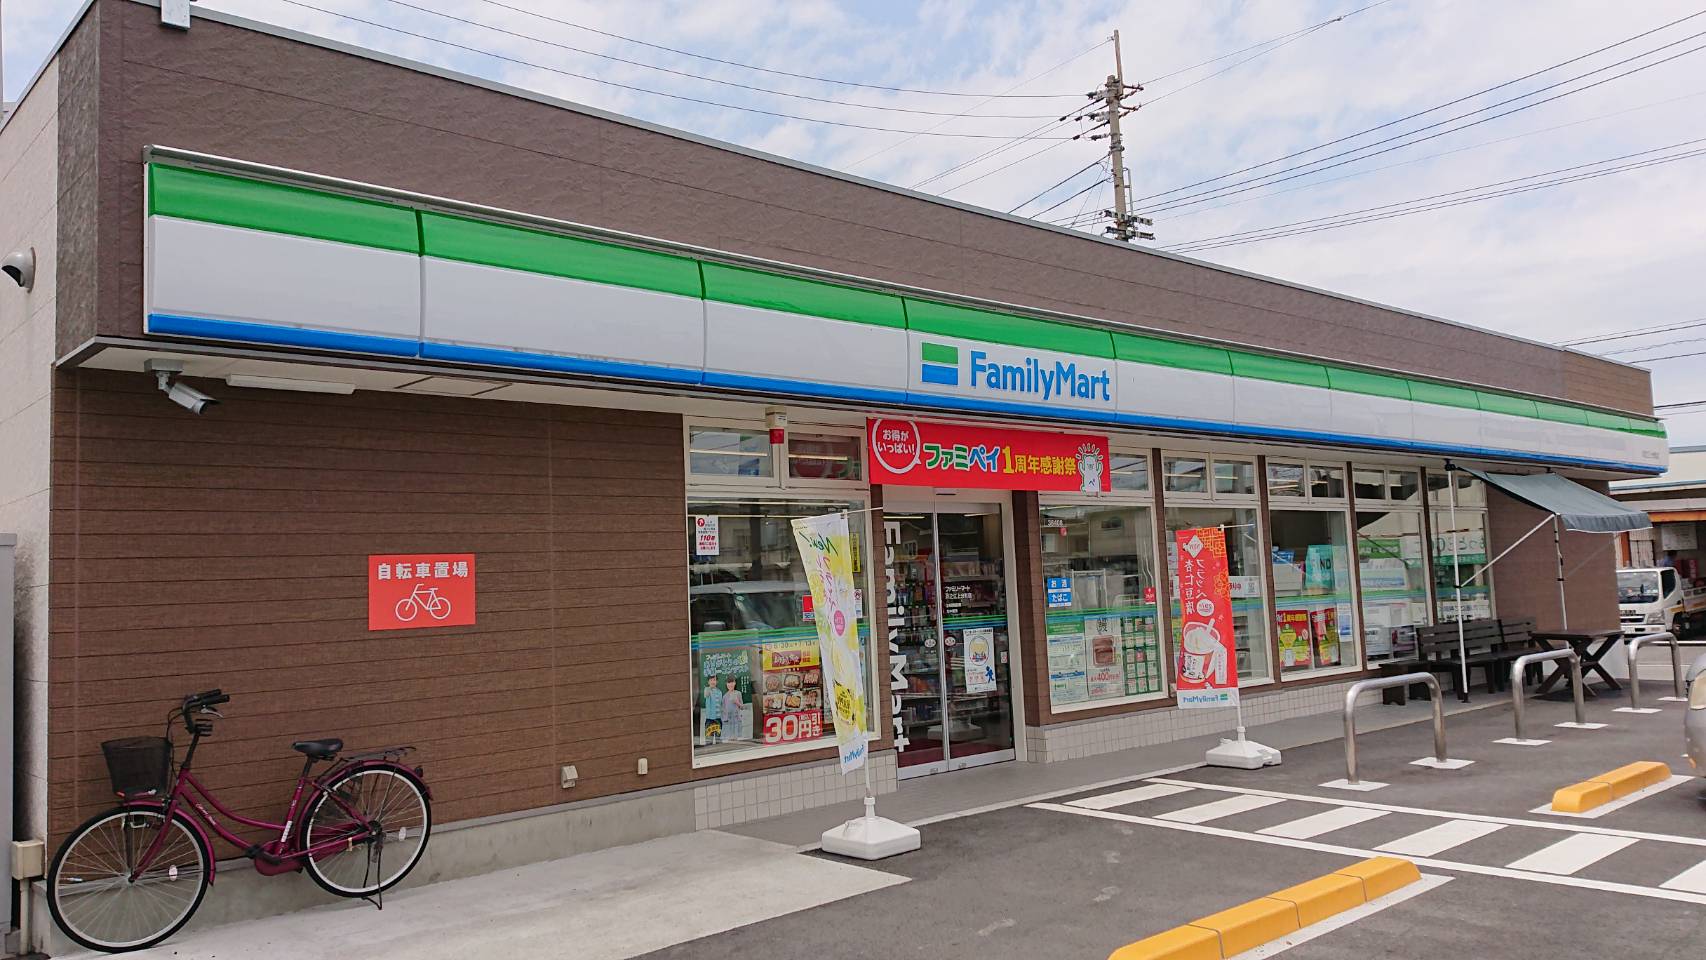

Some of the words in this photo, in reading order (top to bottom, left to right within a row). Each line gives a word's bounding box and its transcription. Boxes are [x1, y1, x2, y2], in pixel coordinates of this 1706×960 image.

[970, 350, 1110, 401] FamilyMart
[882, 429, 909, 441] お得が
[877, 441, 915, 455] いっぱい!
[377, 561, 469, 580] 自転車置場
